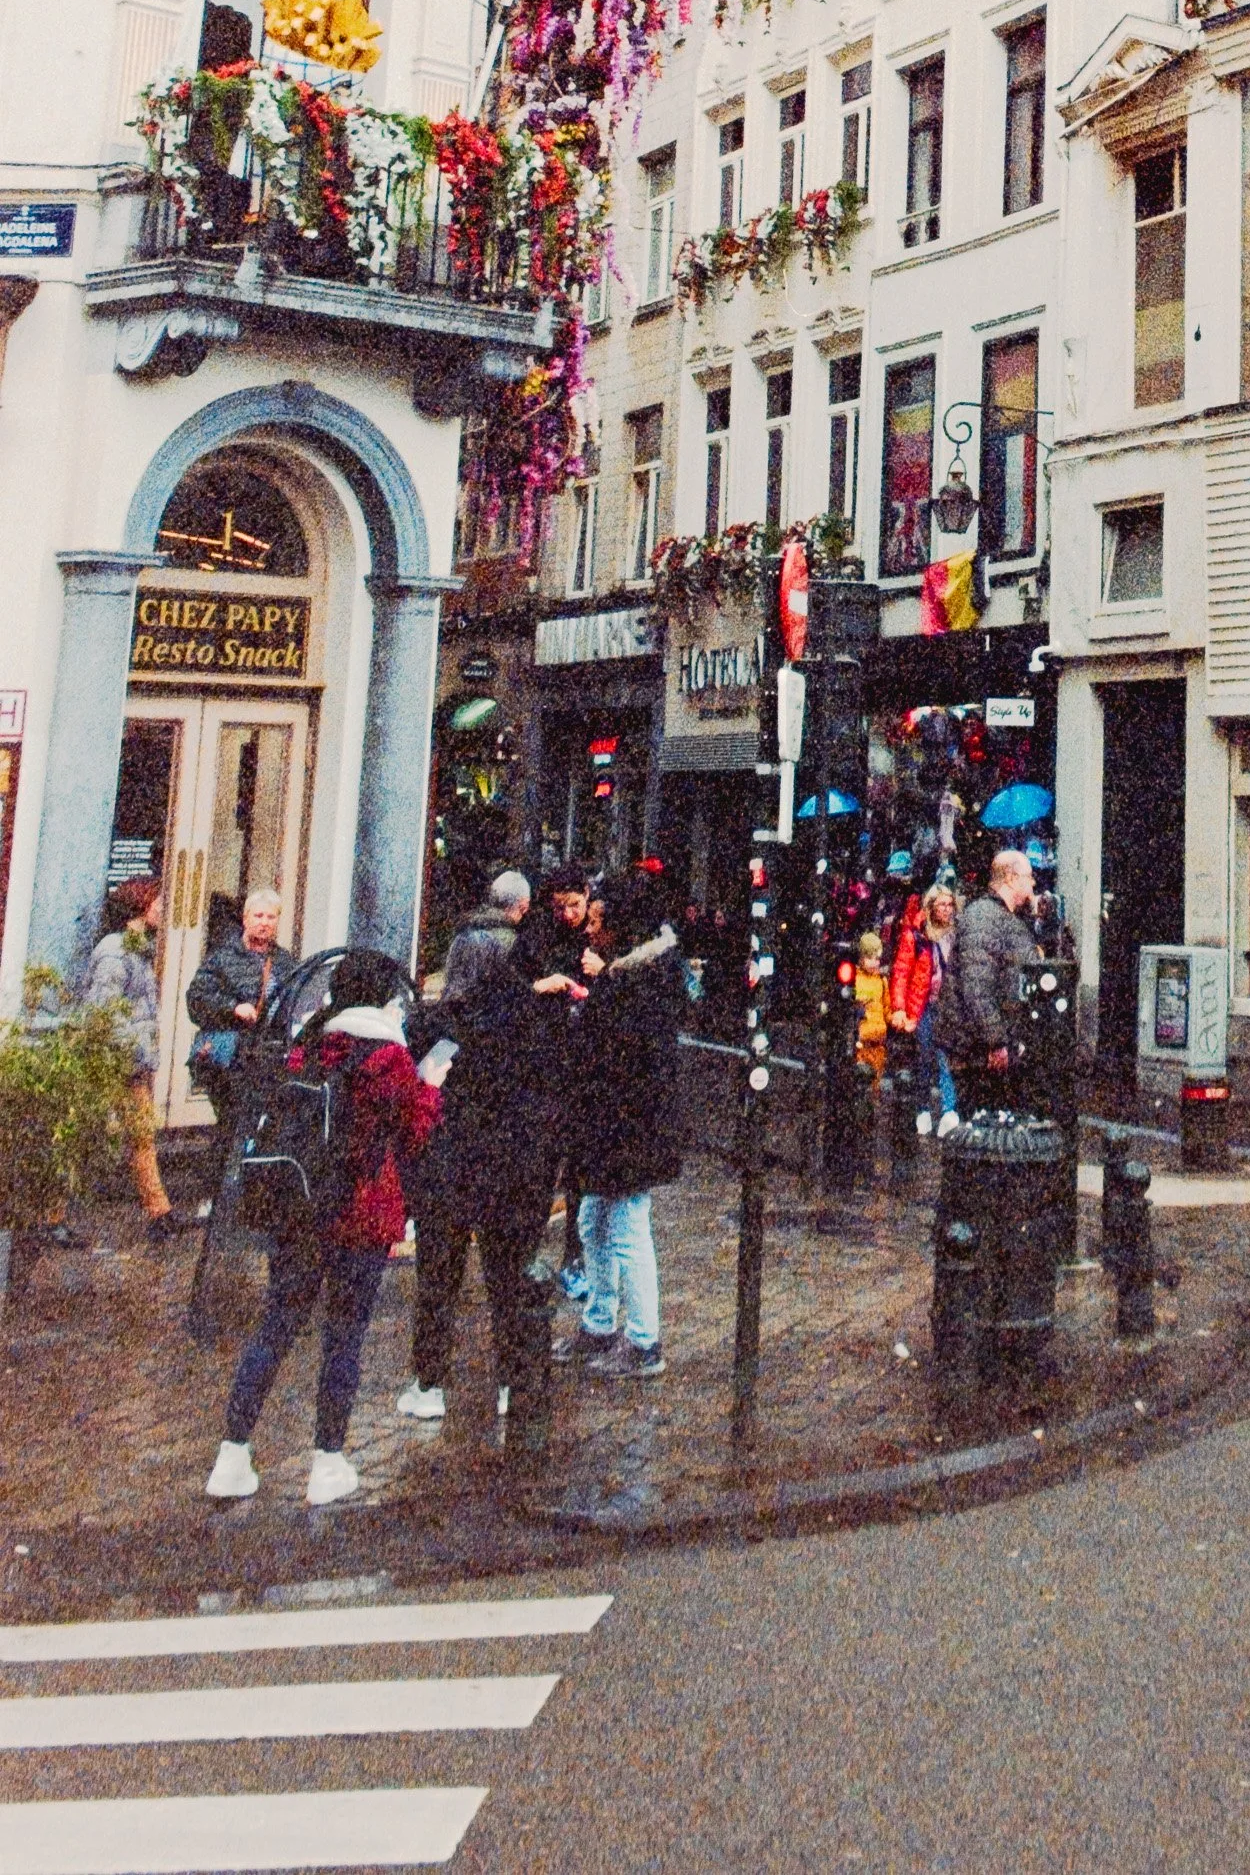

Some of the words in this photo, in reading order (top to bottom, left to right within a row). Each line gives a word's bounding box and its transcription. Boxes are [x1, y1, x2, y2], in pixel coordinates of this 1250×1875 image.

[0, 222, 57, 234] ADELEINE
[138, 598, 219, 629] CHEZ
[224, 603, 301, 634] PAPY
[131, 633, 216, 666] Resto
[218, 638, 302, 670] Snack
